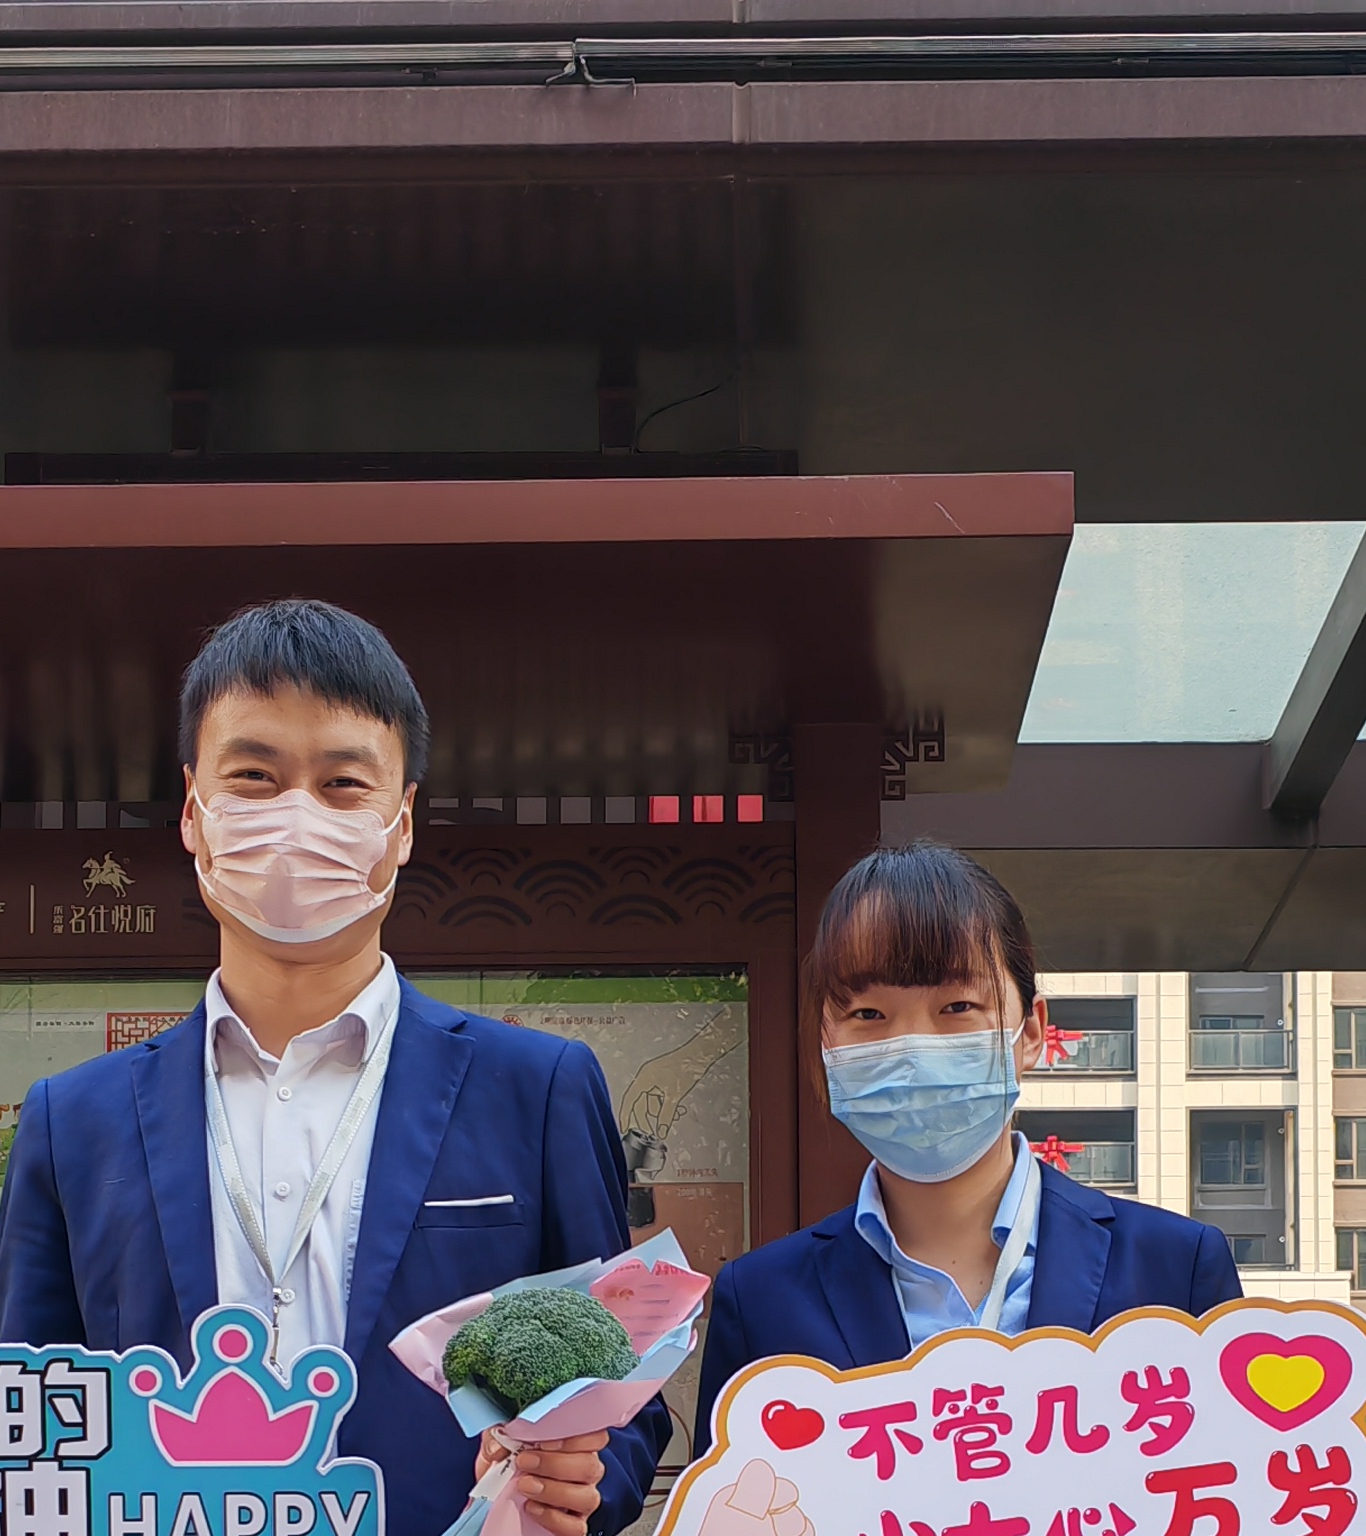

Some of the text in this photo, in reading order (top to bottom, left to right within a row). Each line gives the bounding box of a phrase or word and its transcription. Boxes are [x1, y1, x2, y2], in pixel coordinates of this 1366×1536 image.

[69, 904, 156, 934] 名仕悦府
[838, 1364, 1196, 1482] 不管几岁
